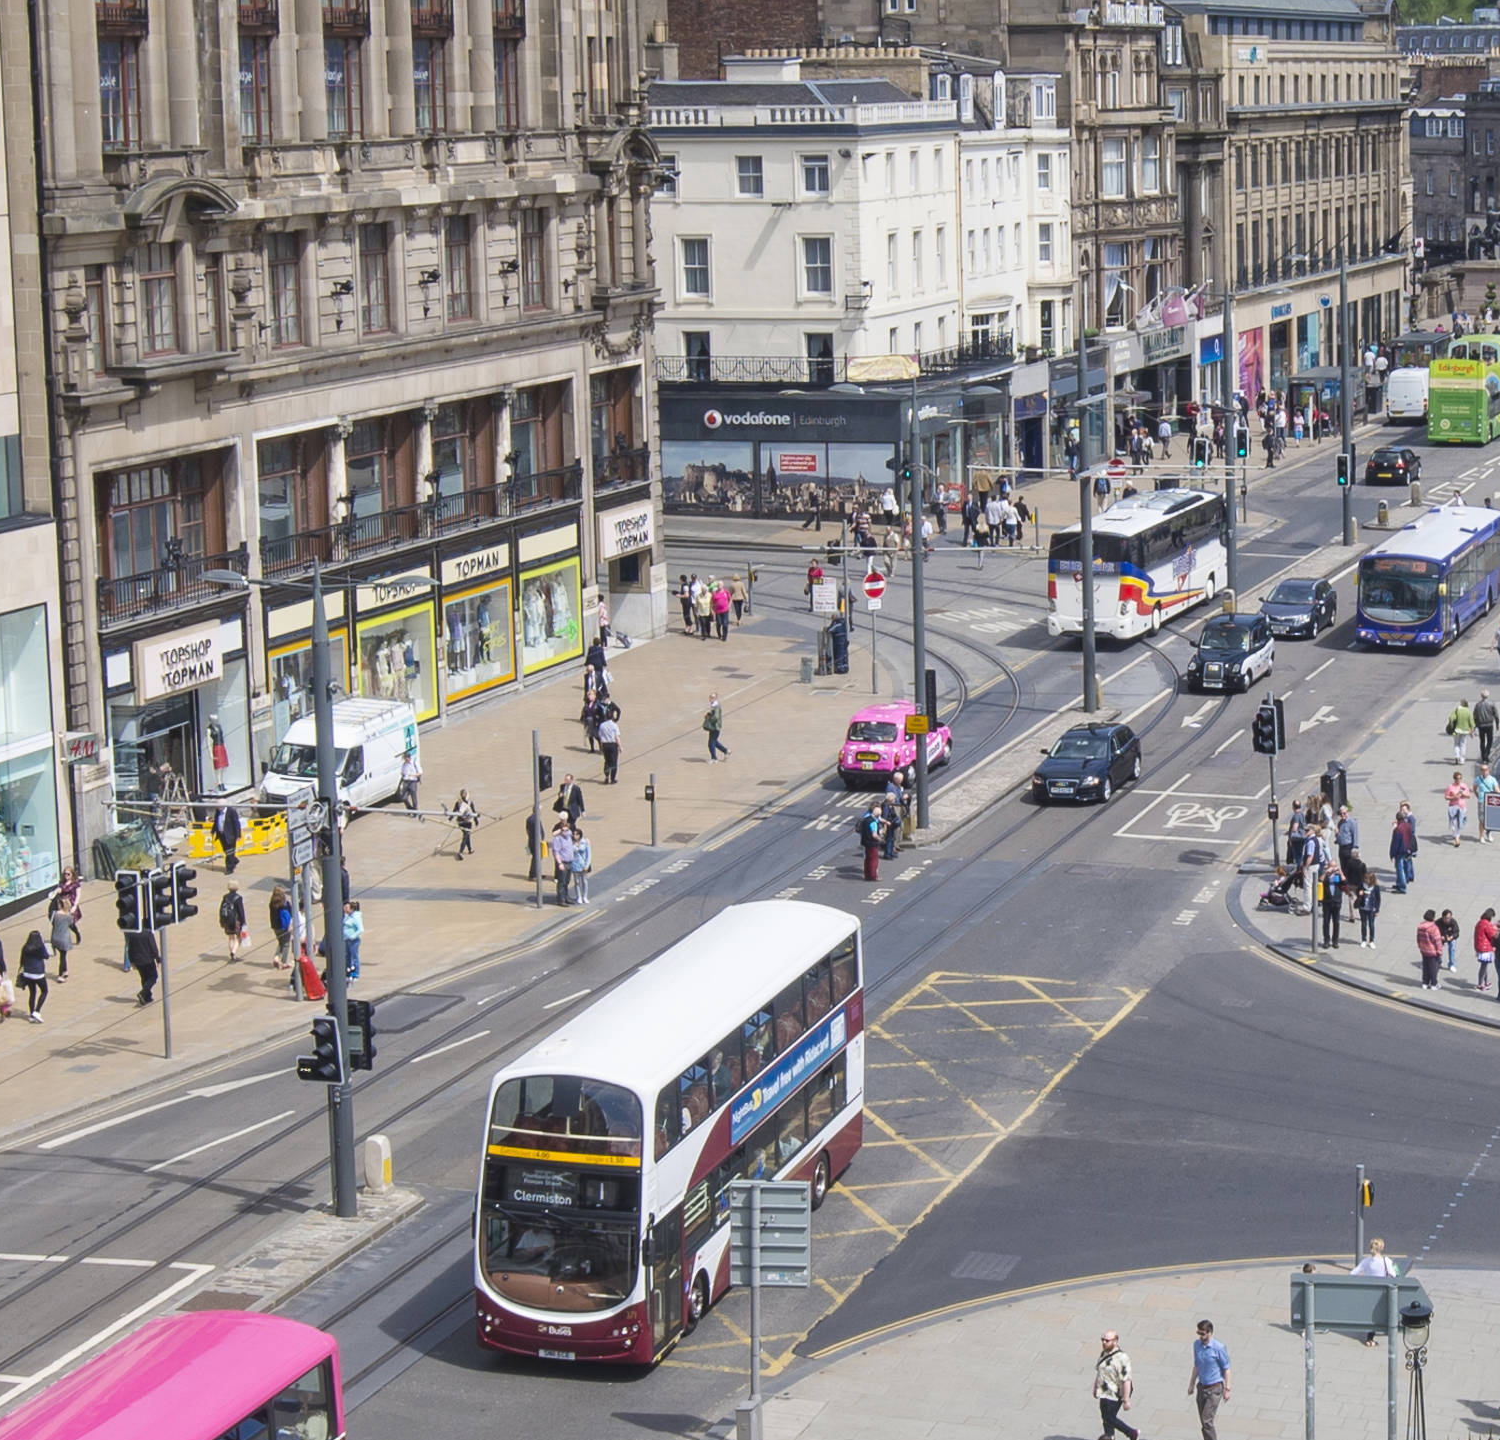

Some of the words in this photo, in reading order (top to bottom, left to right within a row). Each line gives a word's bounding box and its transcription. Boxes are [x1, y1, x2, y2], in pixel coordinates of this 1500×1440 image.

[724, 411, 791, 425] vodafone
[800, 415, 847, 427] Edinburgh
[455, 550, 499, 578] TOPMAN
[163, 638, 212, 667] TOPSHOP
[164, 660, 214, 687] TOPMAN
[513, 1188, 573, 1206] Clermiston
